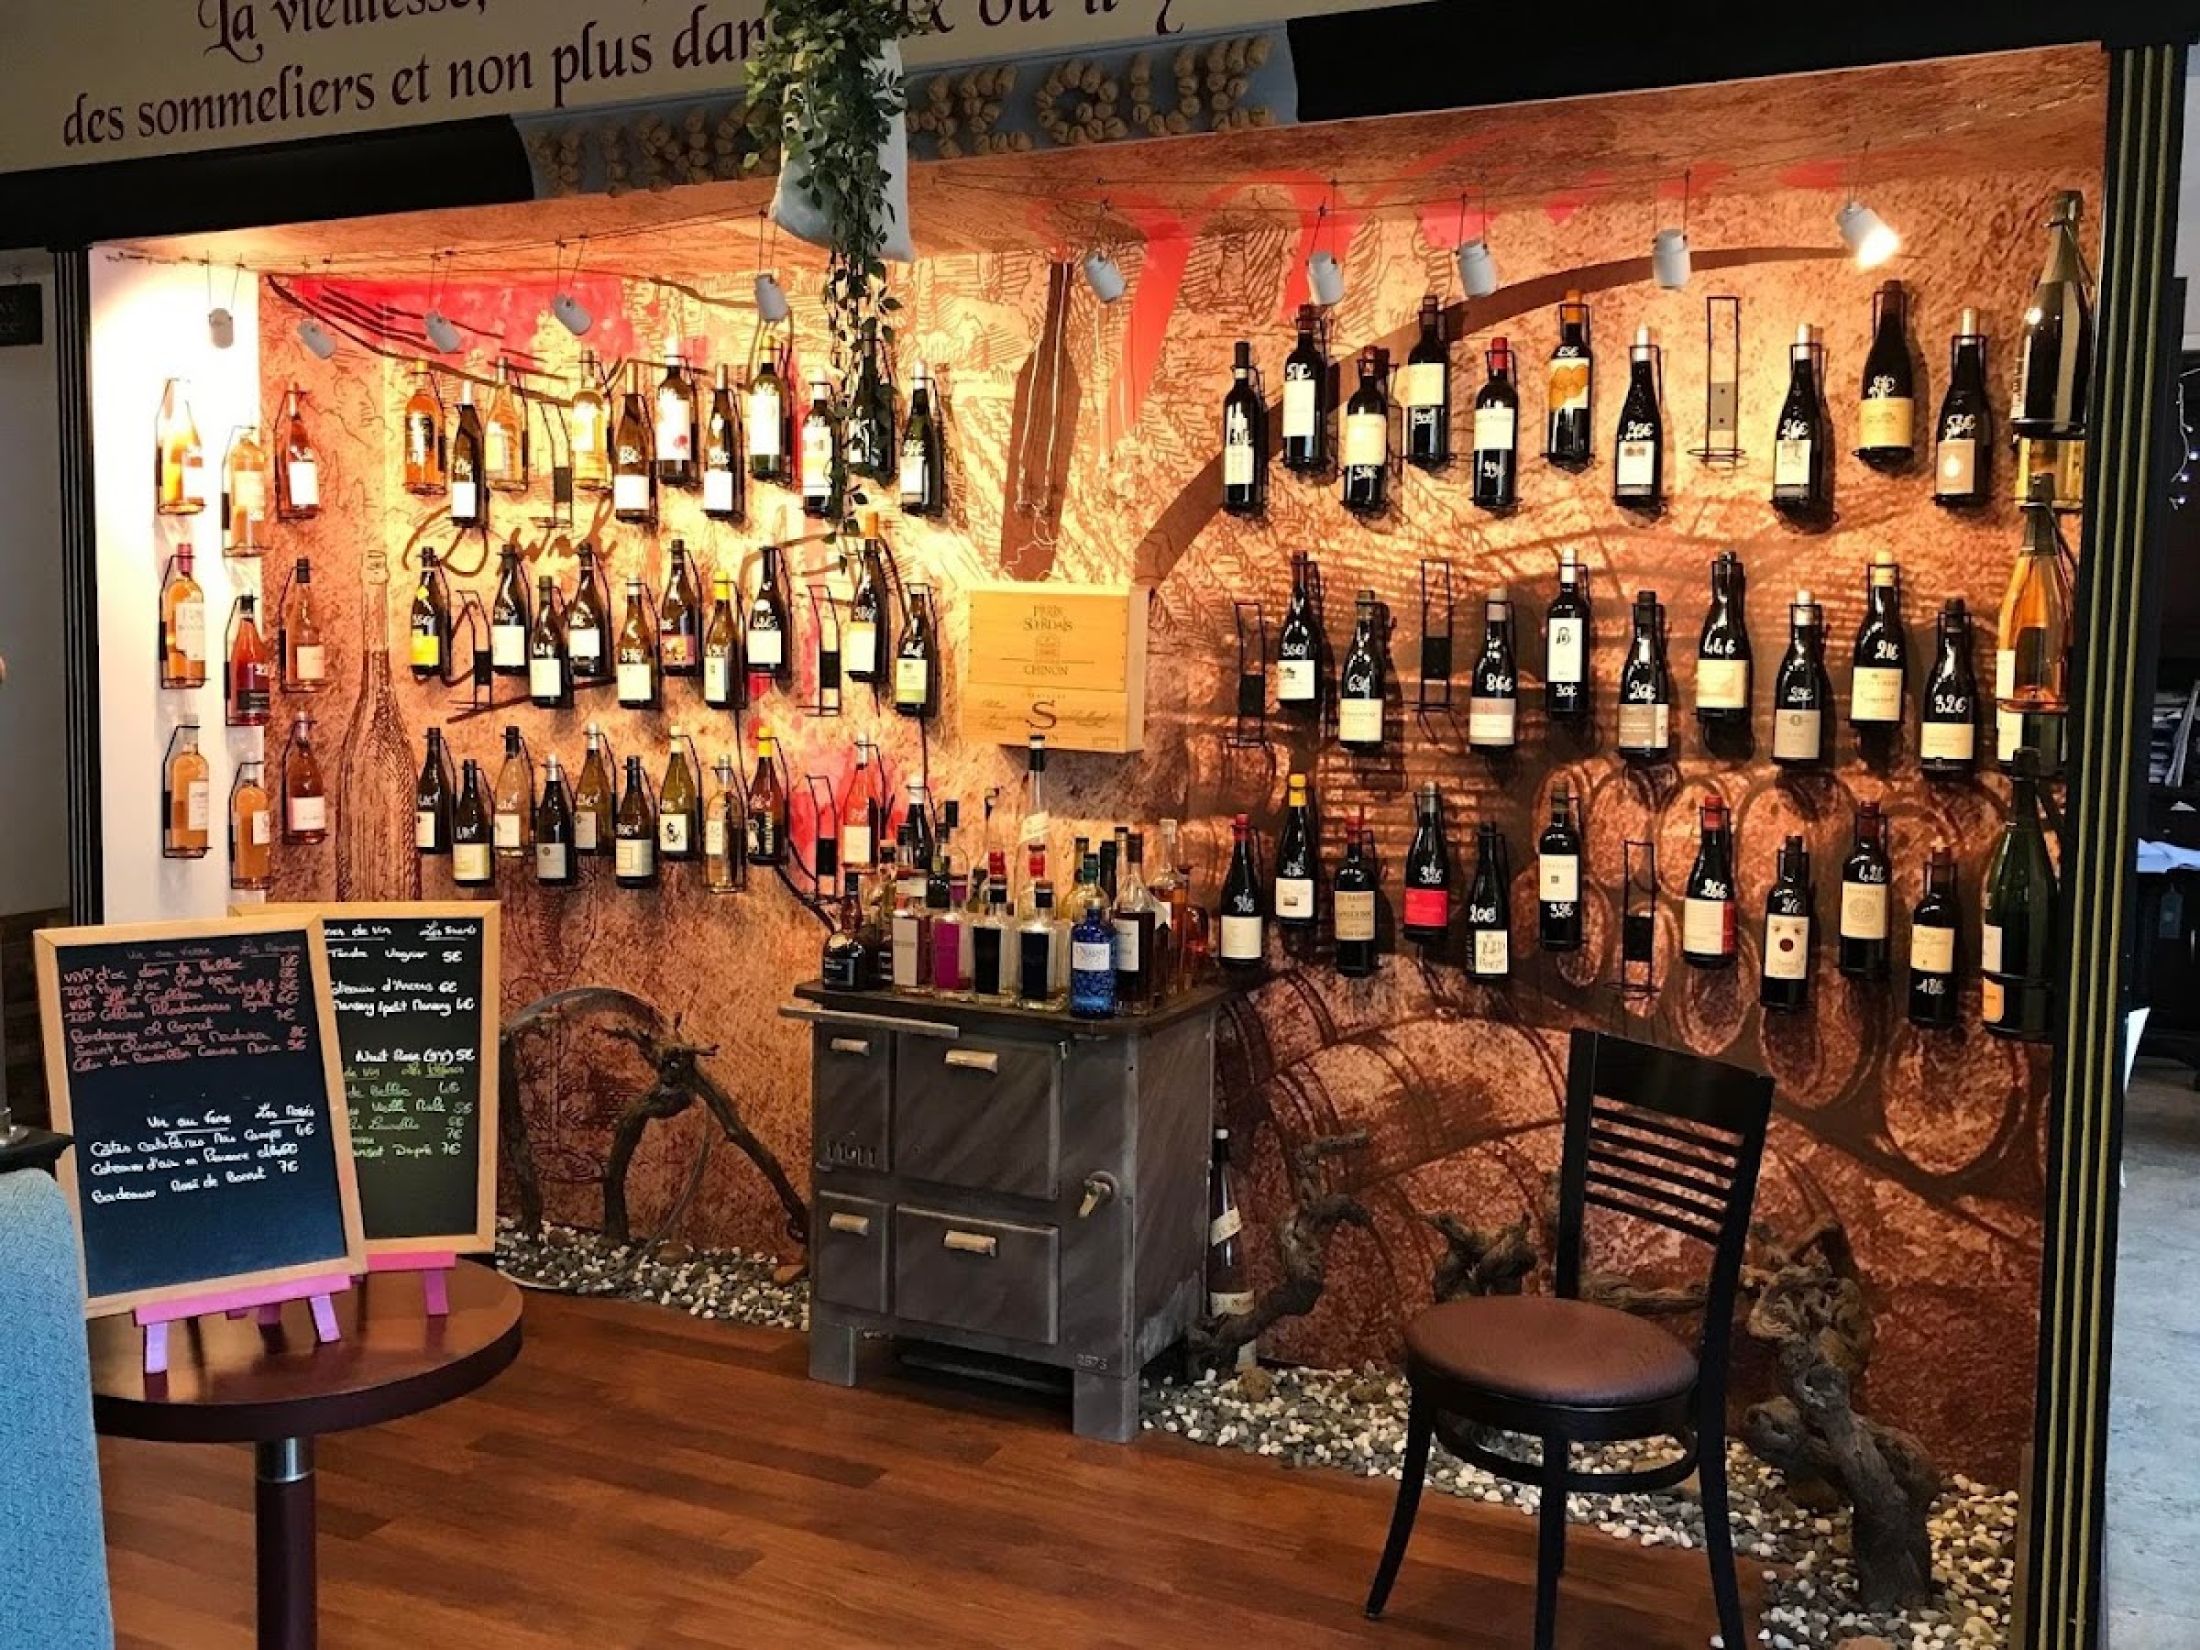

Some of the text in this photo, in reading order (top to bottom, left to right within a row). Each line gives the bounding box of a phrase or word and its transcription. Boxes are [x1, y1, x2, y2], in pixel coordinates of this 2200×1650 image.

[64, 92, 124, 147] des
[138, 65, 374, 138] sommeliers
[392, 53, 430, 105] et
[449, 53, 533, 99] non
[551, 21, 653, 108] plus
[672, 3, 766, 68] dan
[527, 35, 1277, 200] VINOHEQUE
[1023, 664, 1070, 676] CHINON
[1025, 699, 1057, 730] S
